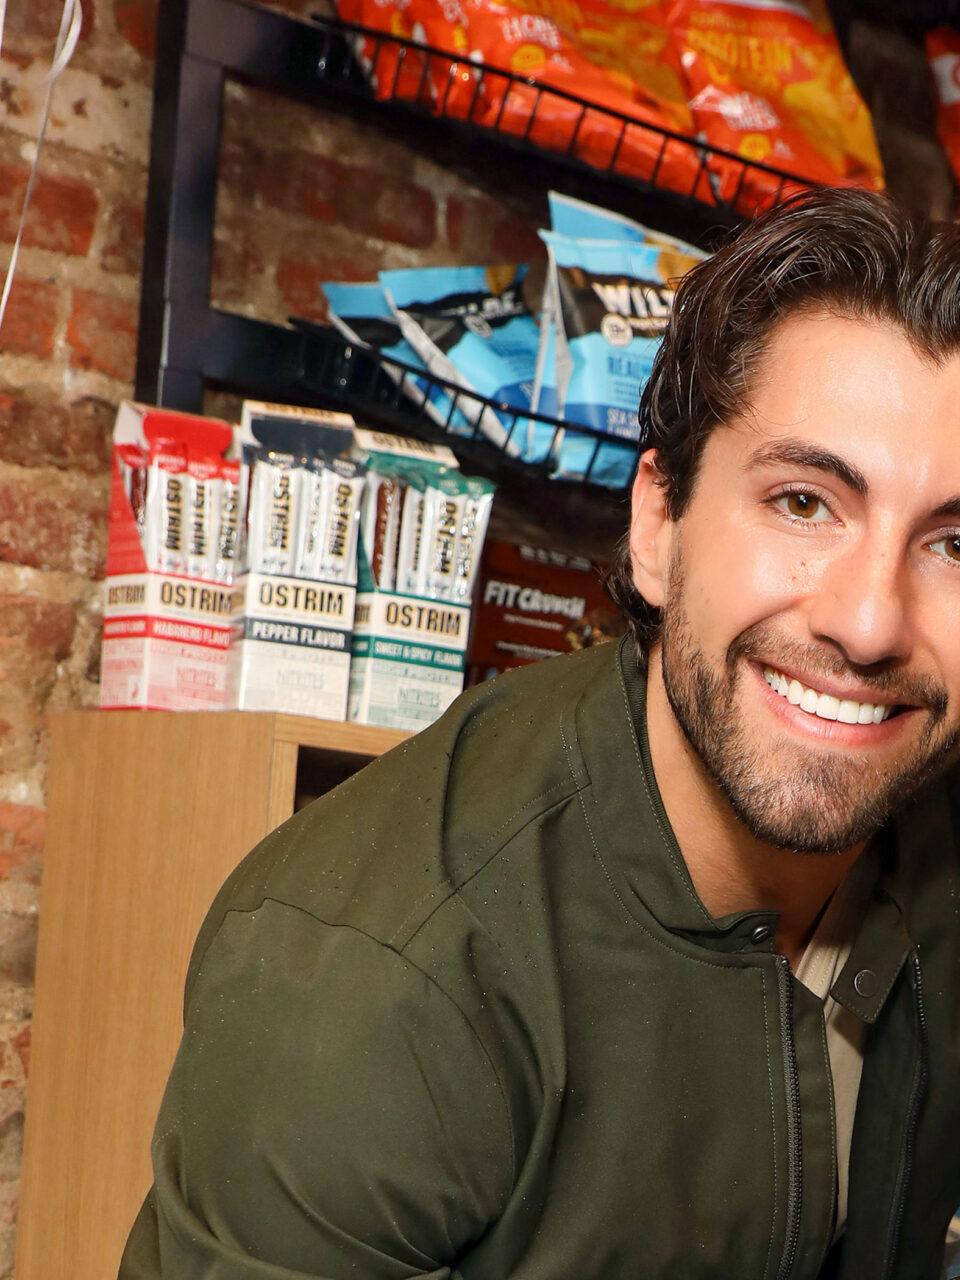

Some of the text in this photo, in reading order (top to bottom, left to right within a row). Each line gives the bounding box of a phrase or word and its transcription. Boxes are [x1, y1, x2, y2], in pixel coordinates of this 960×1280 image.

[591, 282, 675, 317] WIL
[161, 581, 233, 616] OSTRIM
[260, 582, 343, 615] OSTRIM
[251, 622, 299, 642] PEPPER
[300, 627, 346, 649] FLAVOR
[386, 602, 461, 636] OSTRIM
